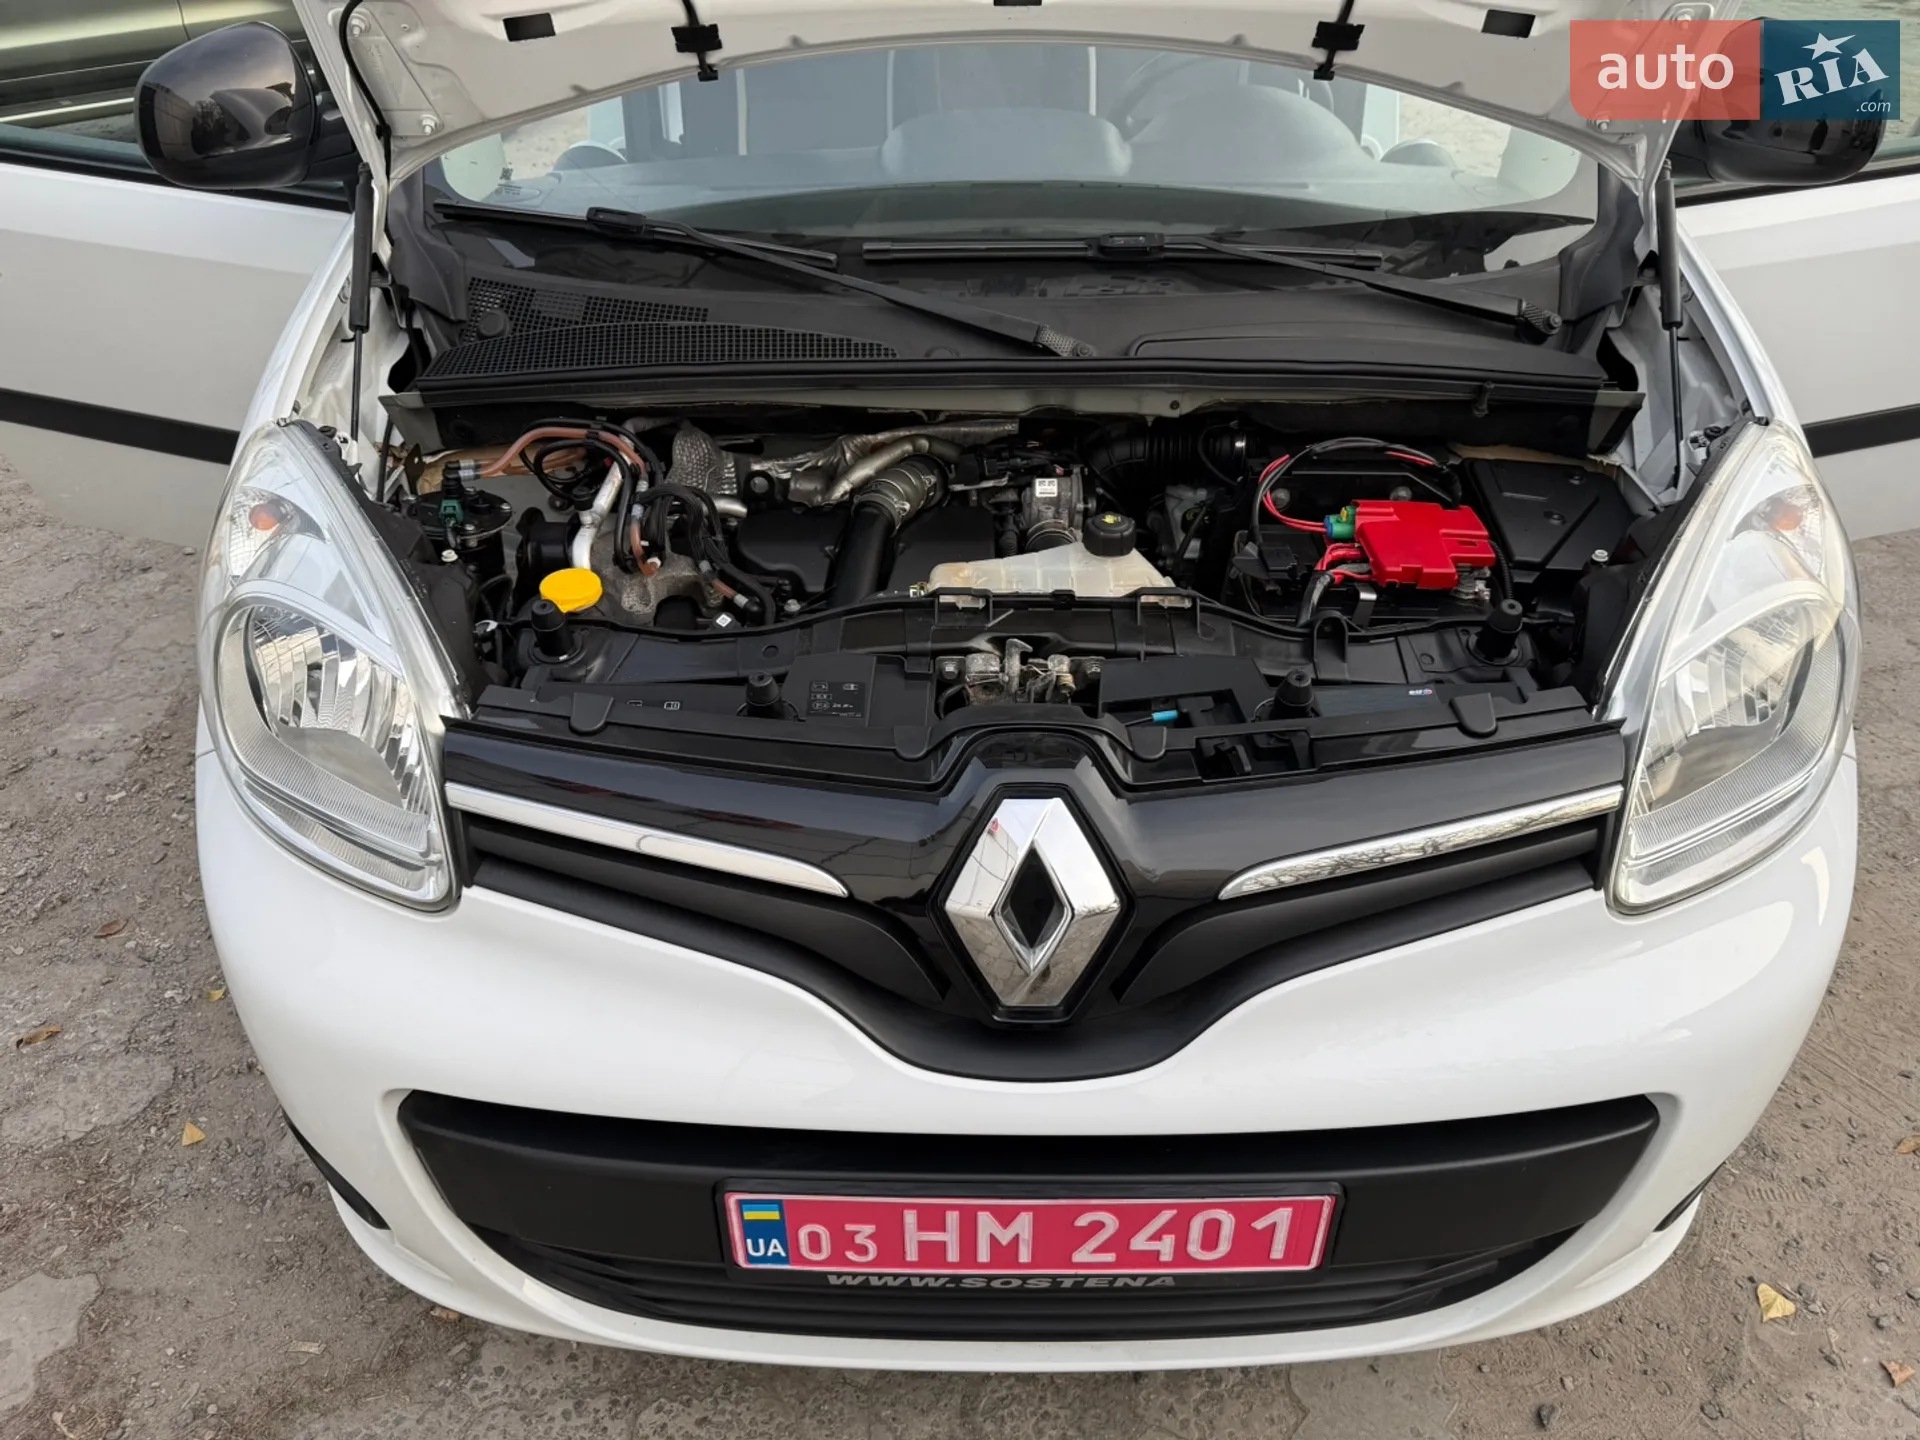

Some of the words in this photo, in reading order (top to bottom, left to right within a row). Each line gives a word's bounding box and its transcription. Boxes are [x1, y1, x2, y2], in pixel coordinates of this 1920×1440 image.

[746, 1238, 787, 1257] UA
[797, 1223, 878, 1262] 03
[903, 1208, 1033, 1263] HM
[1071, 1207, 1293, 1263] 2401
